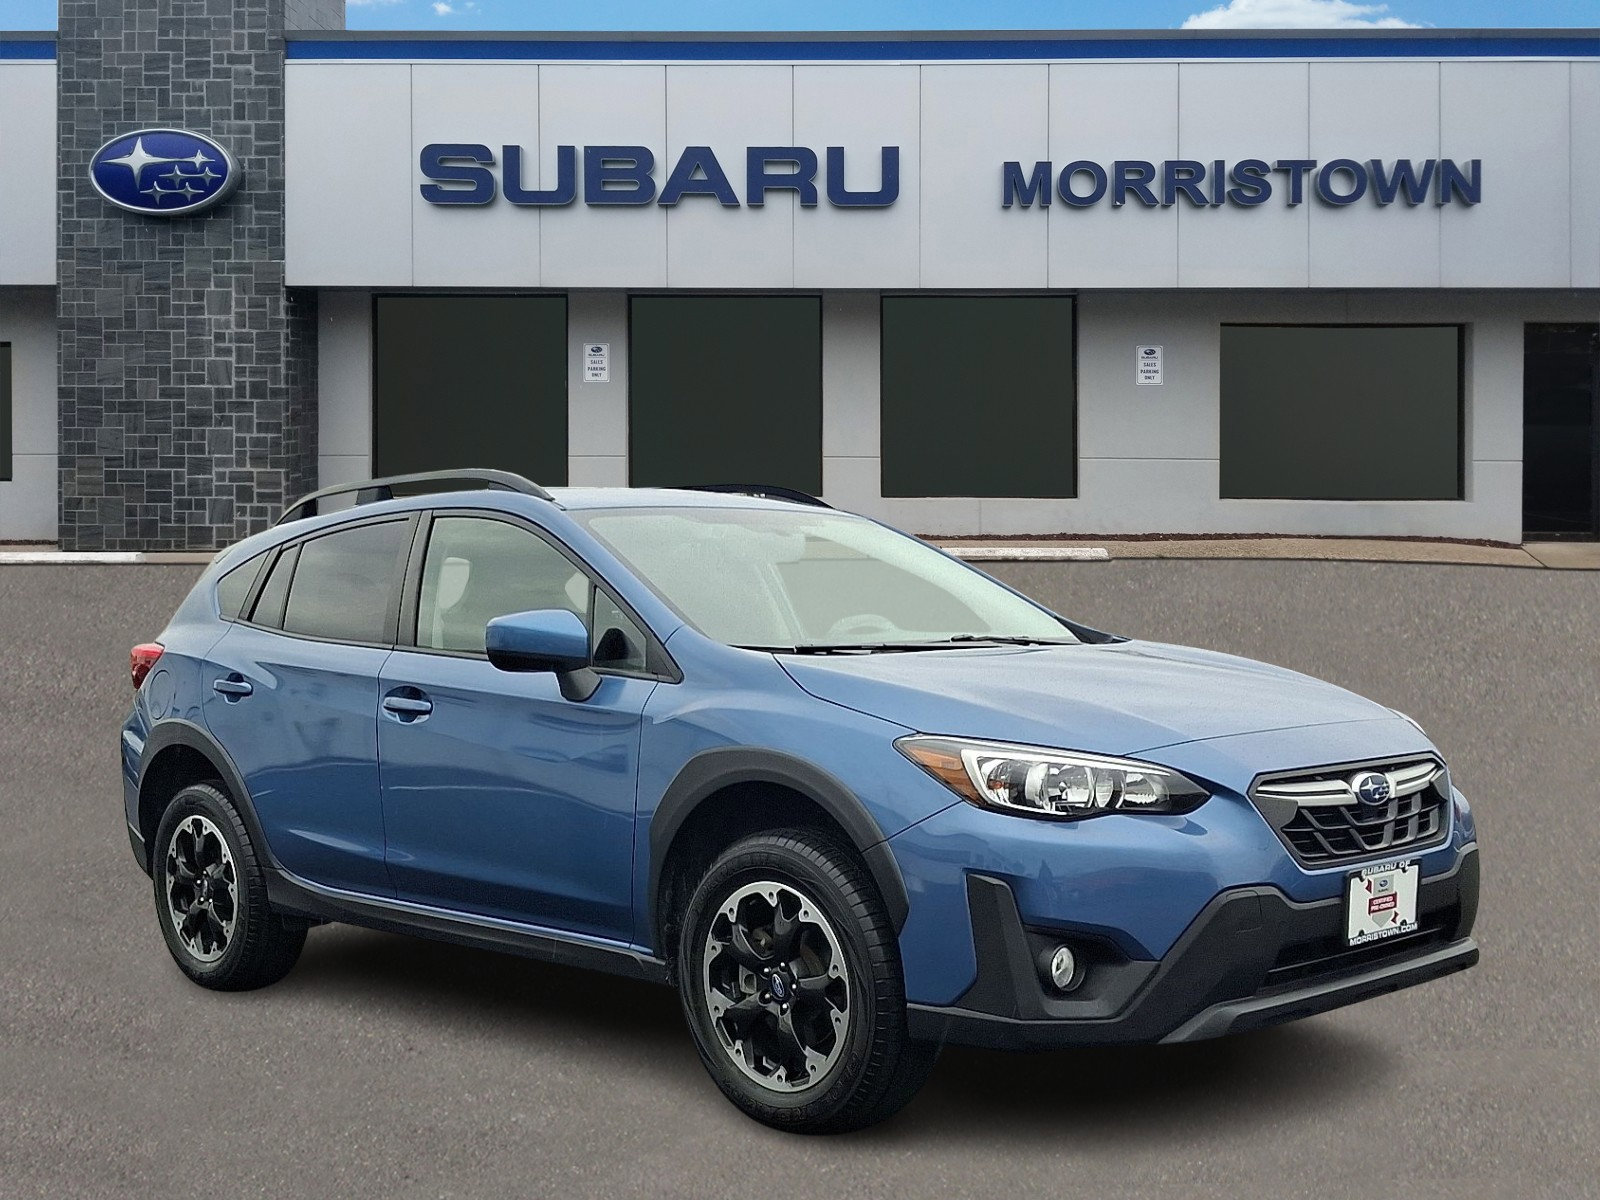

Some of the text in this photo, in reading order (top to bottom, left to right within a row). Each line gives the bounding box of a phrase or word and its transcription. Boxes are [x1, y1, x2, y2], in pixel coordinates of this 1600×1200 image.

[420, 144, 900, 207] SUBARU
[1002, 158, 1482, 208] MORRISTOWN
[1361, 860, 1411, 877] SUBARU OF
[1350, 922, 1418, 946] MORRISTOWN.COM
